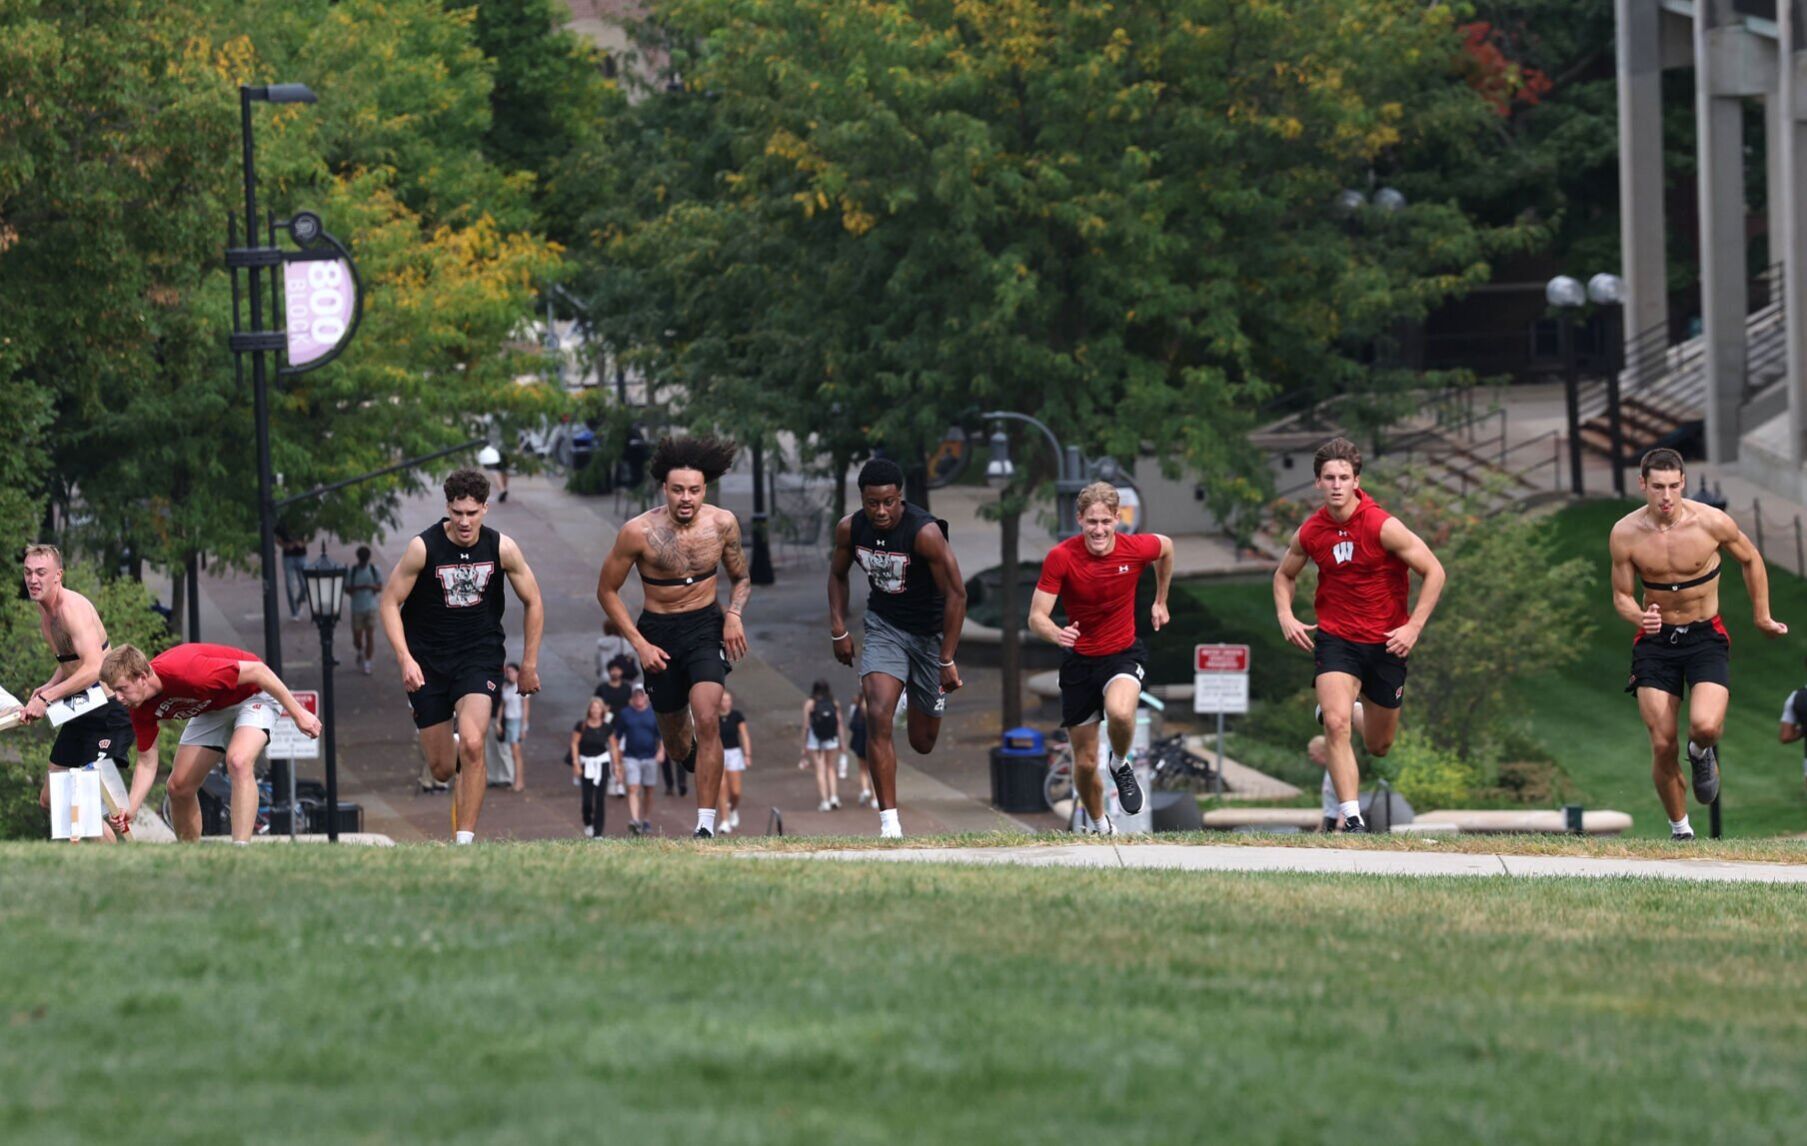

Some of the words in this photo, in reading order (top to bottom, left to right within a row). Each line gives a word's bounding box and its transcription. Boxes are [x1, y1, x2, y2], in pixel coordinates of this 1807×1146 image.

[288, 279, 310, 345] BLOCK
[308, 260, 344, 345] 800
[1333, 541, 1354, 565] W
[436, 561, 494, 608] W
